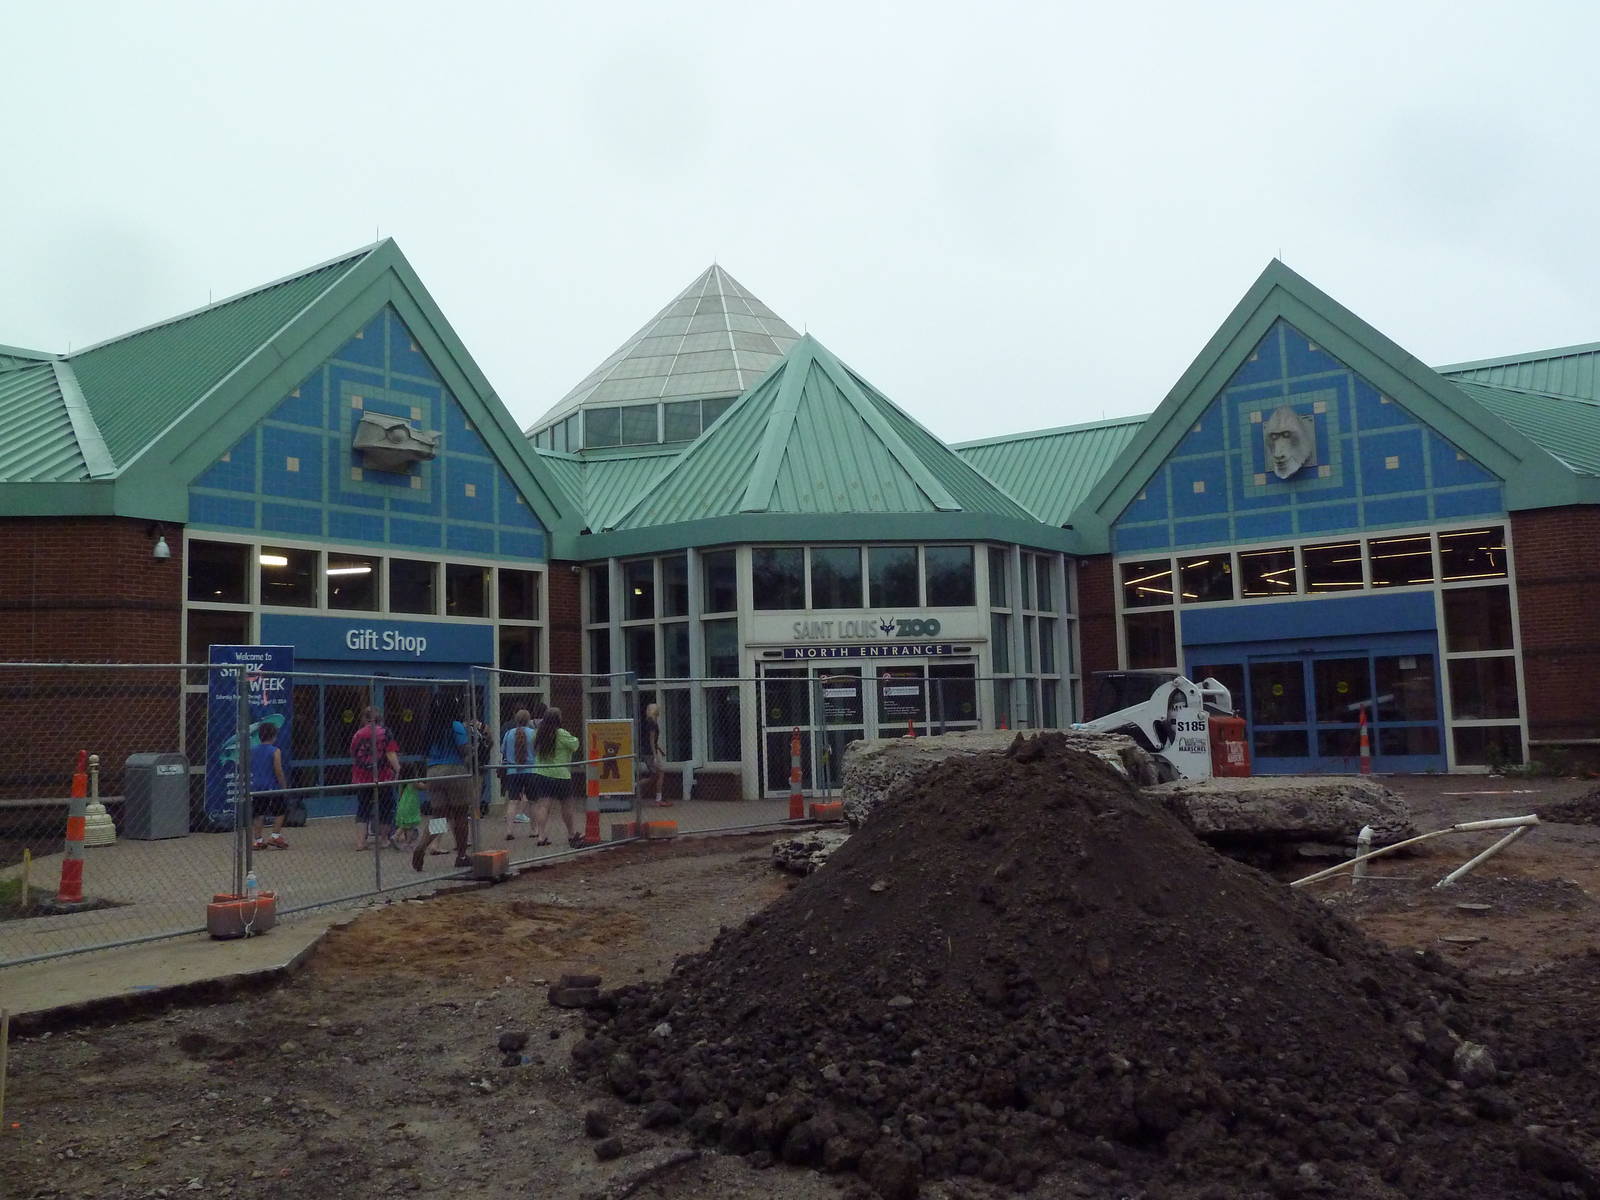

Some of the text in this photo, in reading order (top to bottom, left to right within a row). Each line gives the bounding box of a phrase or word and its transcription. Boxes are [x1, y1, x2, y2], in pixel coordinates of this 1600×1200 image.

[792, 618, 941, 640] SAINT LOUIS ZOO
[345, 629, 427, 656] Gift Shop
[235, 651, 272, 661] Welcome to
[795, 645, 943, 657] NORTH ENTRANCE
[220, 662, 263, 677] SHRK
[249, 676, 286, 692] WEEK
[1177, 721, 1206, 732] S185
